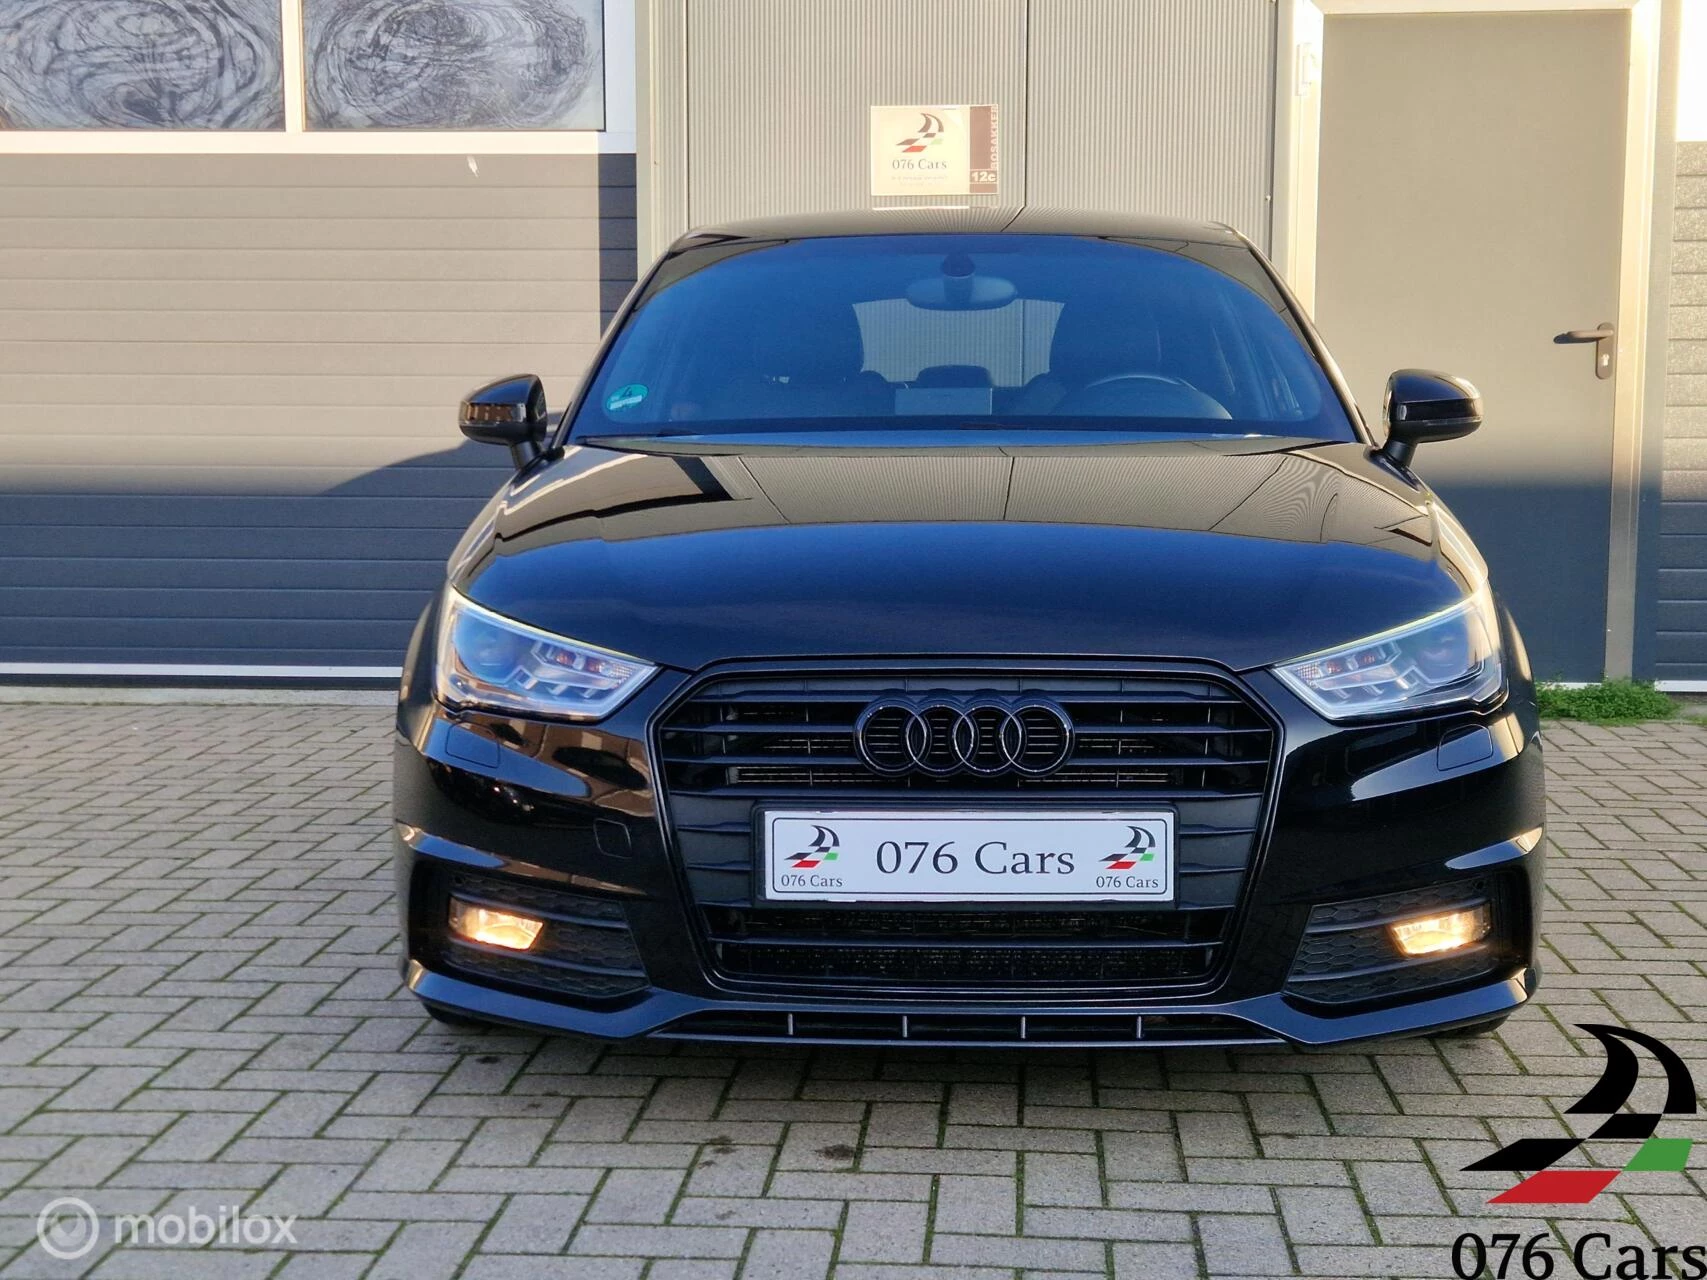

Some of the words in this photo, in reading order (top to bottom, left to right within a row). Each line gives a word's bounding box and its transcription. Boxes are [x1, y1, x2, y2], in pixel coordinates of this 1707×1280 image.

[892, 159, 914, 170] 076
[918, 158, 947, 170] Cars
[971, 171, 997, 183] 12c
[876, 840, 959, 875] 076
[974, 841, 1075, 875] Cars
[780, 874, 806, 888] 076
[809, 874, 843, 889] Cars
[1095, 875, 1122, 889] 076
[1125, 875, 1159, 889] Cars
